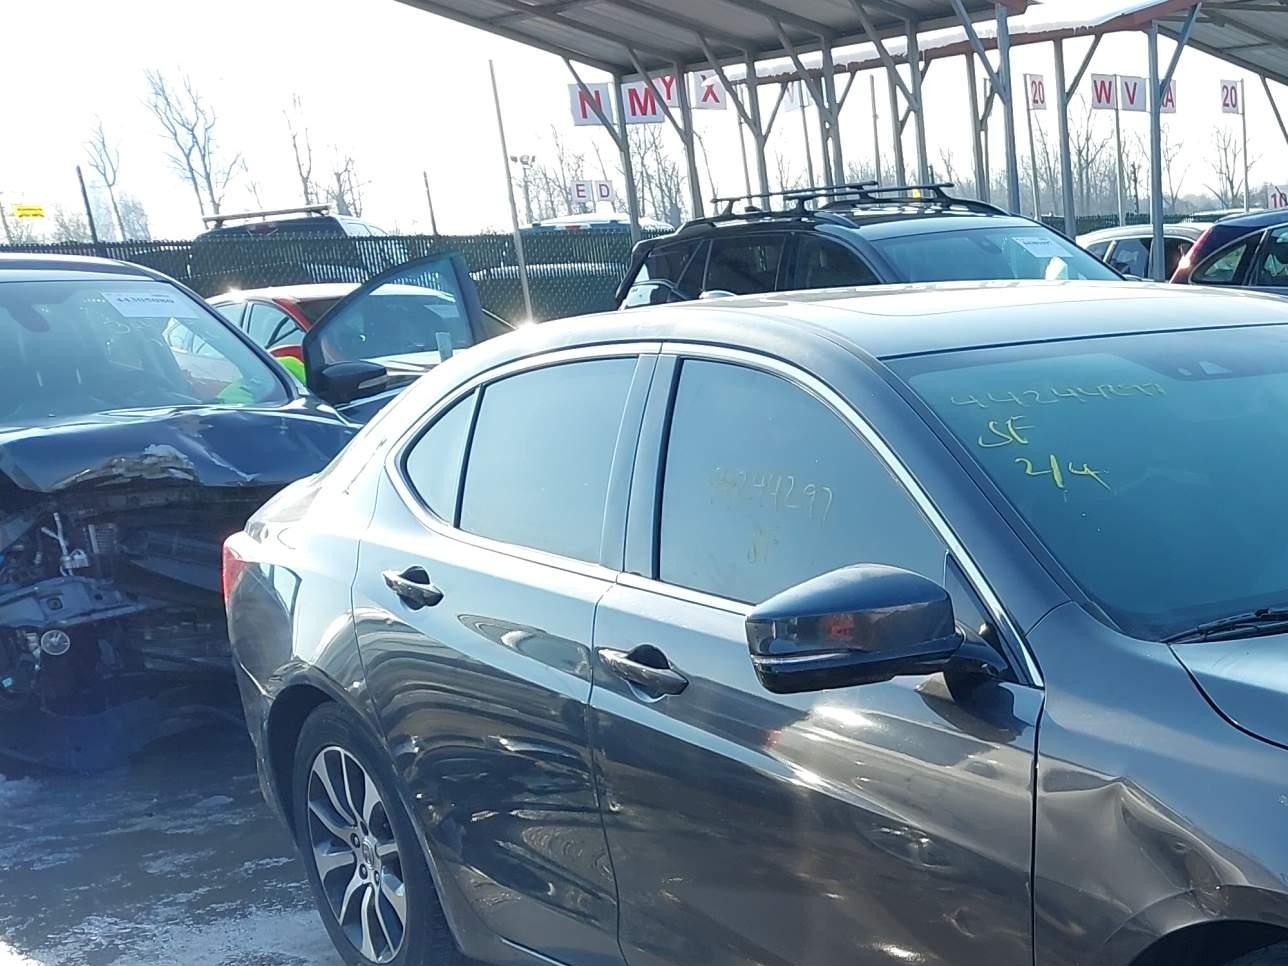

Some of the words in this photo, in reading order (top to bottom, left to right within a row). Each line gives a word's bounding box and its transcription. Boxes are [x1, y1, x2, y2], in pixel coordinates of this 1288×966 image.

[658, 75, 677, 100] Y
[1030, 81, 1045, 104] 20
[1093, 79, 1112, 104] W
[1124, 81, 1137, 105] V
[1221, 85, 1237, 108] 20
[578, 90, 601, 119] N
[627, 87, 657, 117] M
[575, 183, 587, 198] E
[598, 183, 610, 198] D
